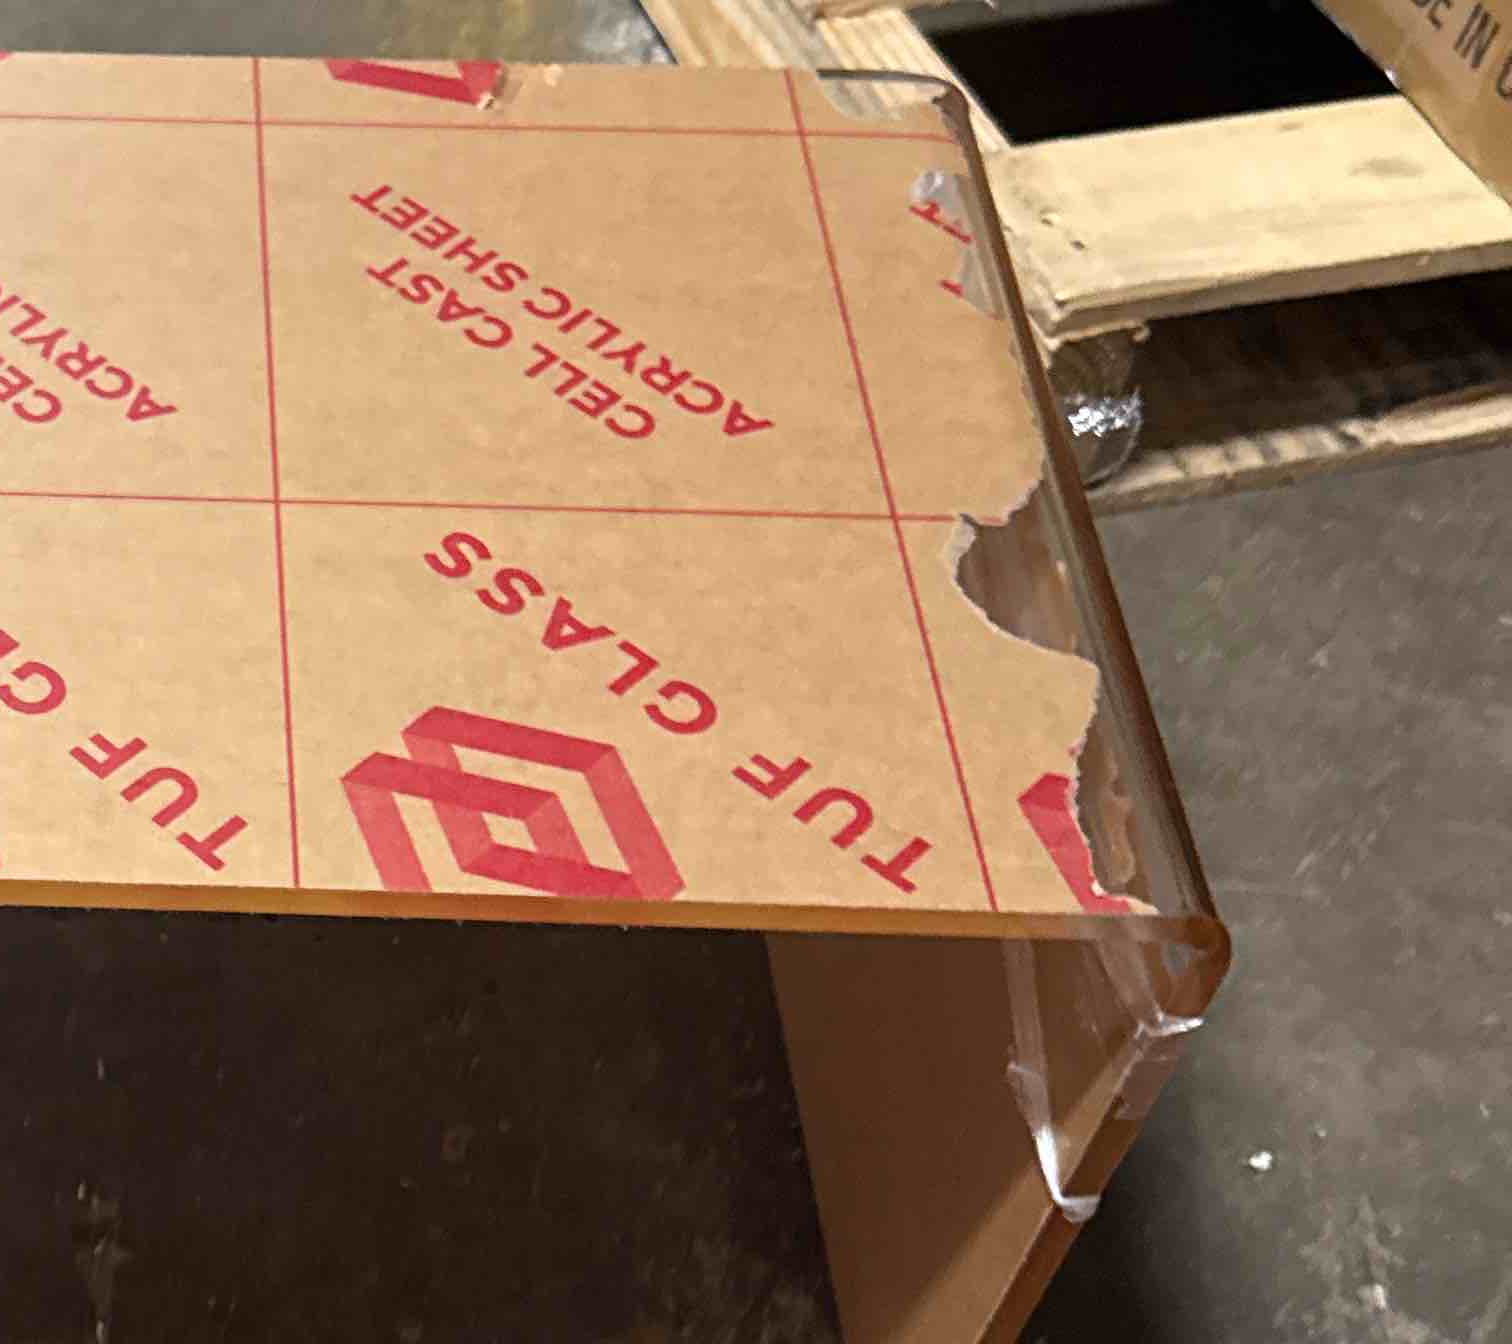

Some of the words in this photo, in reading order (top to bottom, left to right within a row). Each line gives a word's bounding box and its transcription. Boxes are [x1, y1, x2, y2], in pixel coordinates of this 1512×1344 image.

[1452, 2, 1502, 70] IN
[351, 184, 529, 293] SHEET
[367, 256, 514, 349] CAST
[522, 287, 774, 437] ACRYLIC
[527, 341, 655, 439] CELL
[424, 529, 719, 736] GLASS
[70, 734, 247, 873] TUF
[731, 752, 933, 895] TUF
